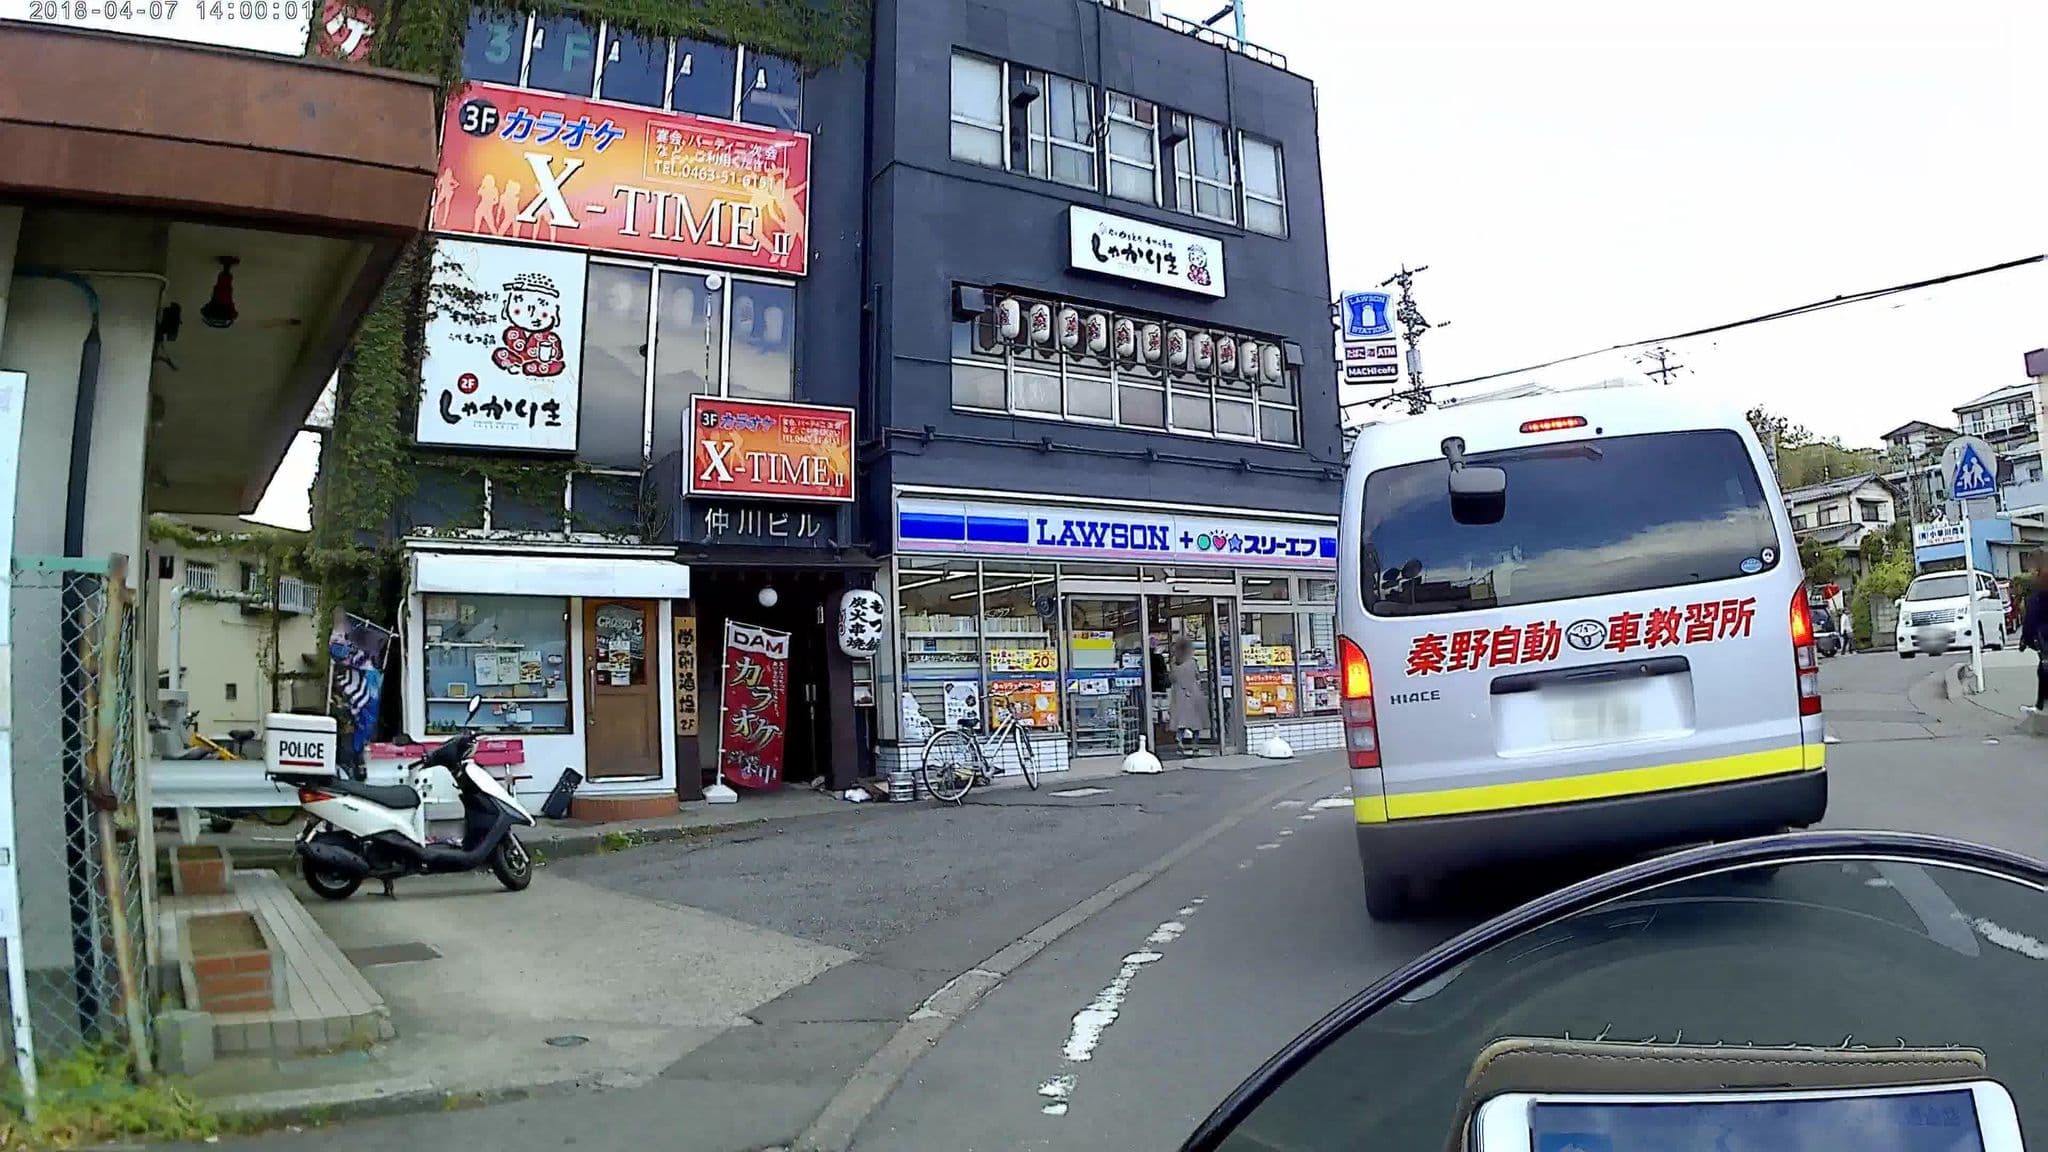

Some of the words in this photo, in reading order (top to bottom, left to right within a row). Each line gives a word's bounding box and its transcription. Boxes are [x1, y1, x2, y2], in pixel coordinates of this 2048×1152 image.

[462, 104, 499, 134] 3F
[500, 107, 625, 152] カラオケ
[1377, 347, 1396, 357] ATM
[461, 378, 475, 390] 2F
[440, 388, 562, 428] しゃかりき
[702, 413, 717, 426] 3F
[719, 412, 777, 433] カラオケ
[704, 507, 821, 538] 仲川ビル
[1036, 518, 1170, 551] LAWSON
[1244, 535, 1317, 557] スリーエフ
[734, 630, 784, 655] DAM
[1405, 619, 1563, 677] 秦野自動
[1603, 597, 1757, 653] 車教習所
[1033, 655, 1050, 669] 20
[730, 657, 784, 750] カラオケ
[1390, 690, 1441, 705] HIACE
[279, 740, 325, 759] POLICE
